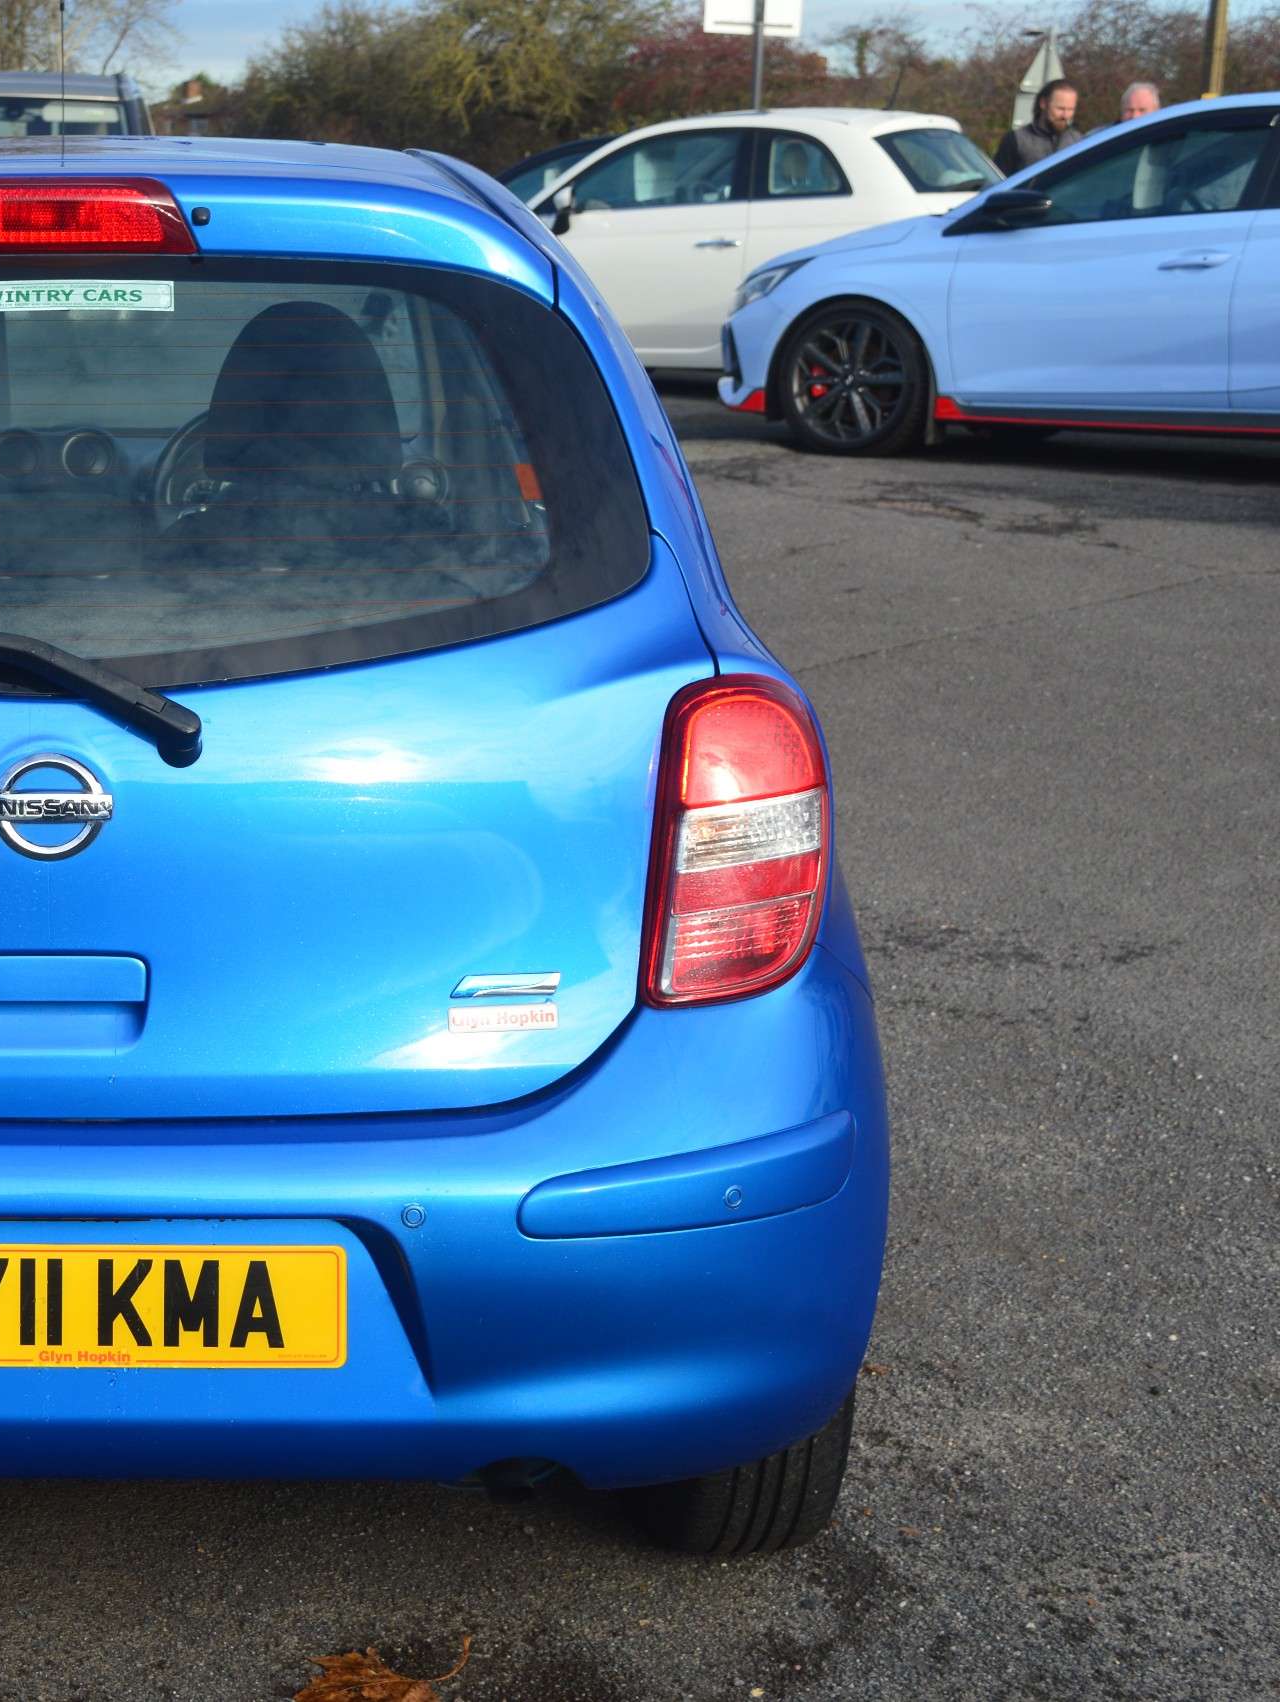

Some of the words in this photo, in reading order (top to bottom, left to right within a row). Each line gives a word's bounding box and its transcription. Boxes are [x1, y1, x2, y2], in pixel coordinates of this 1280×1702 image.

[83, 289, 143, 302] CARS
[496, 1009, 555, 1027] Hopkin
[97, 1258, 285, 1349] KMA
[38, 1350, 73, 1364] Glyn
[77, 1351, 131, 1365] Hopkin
